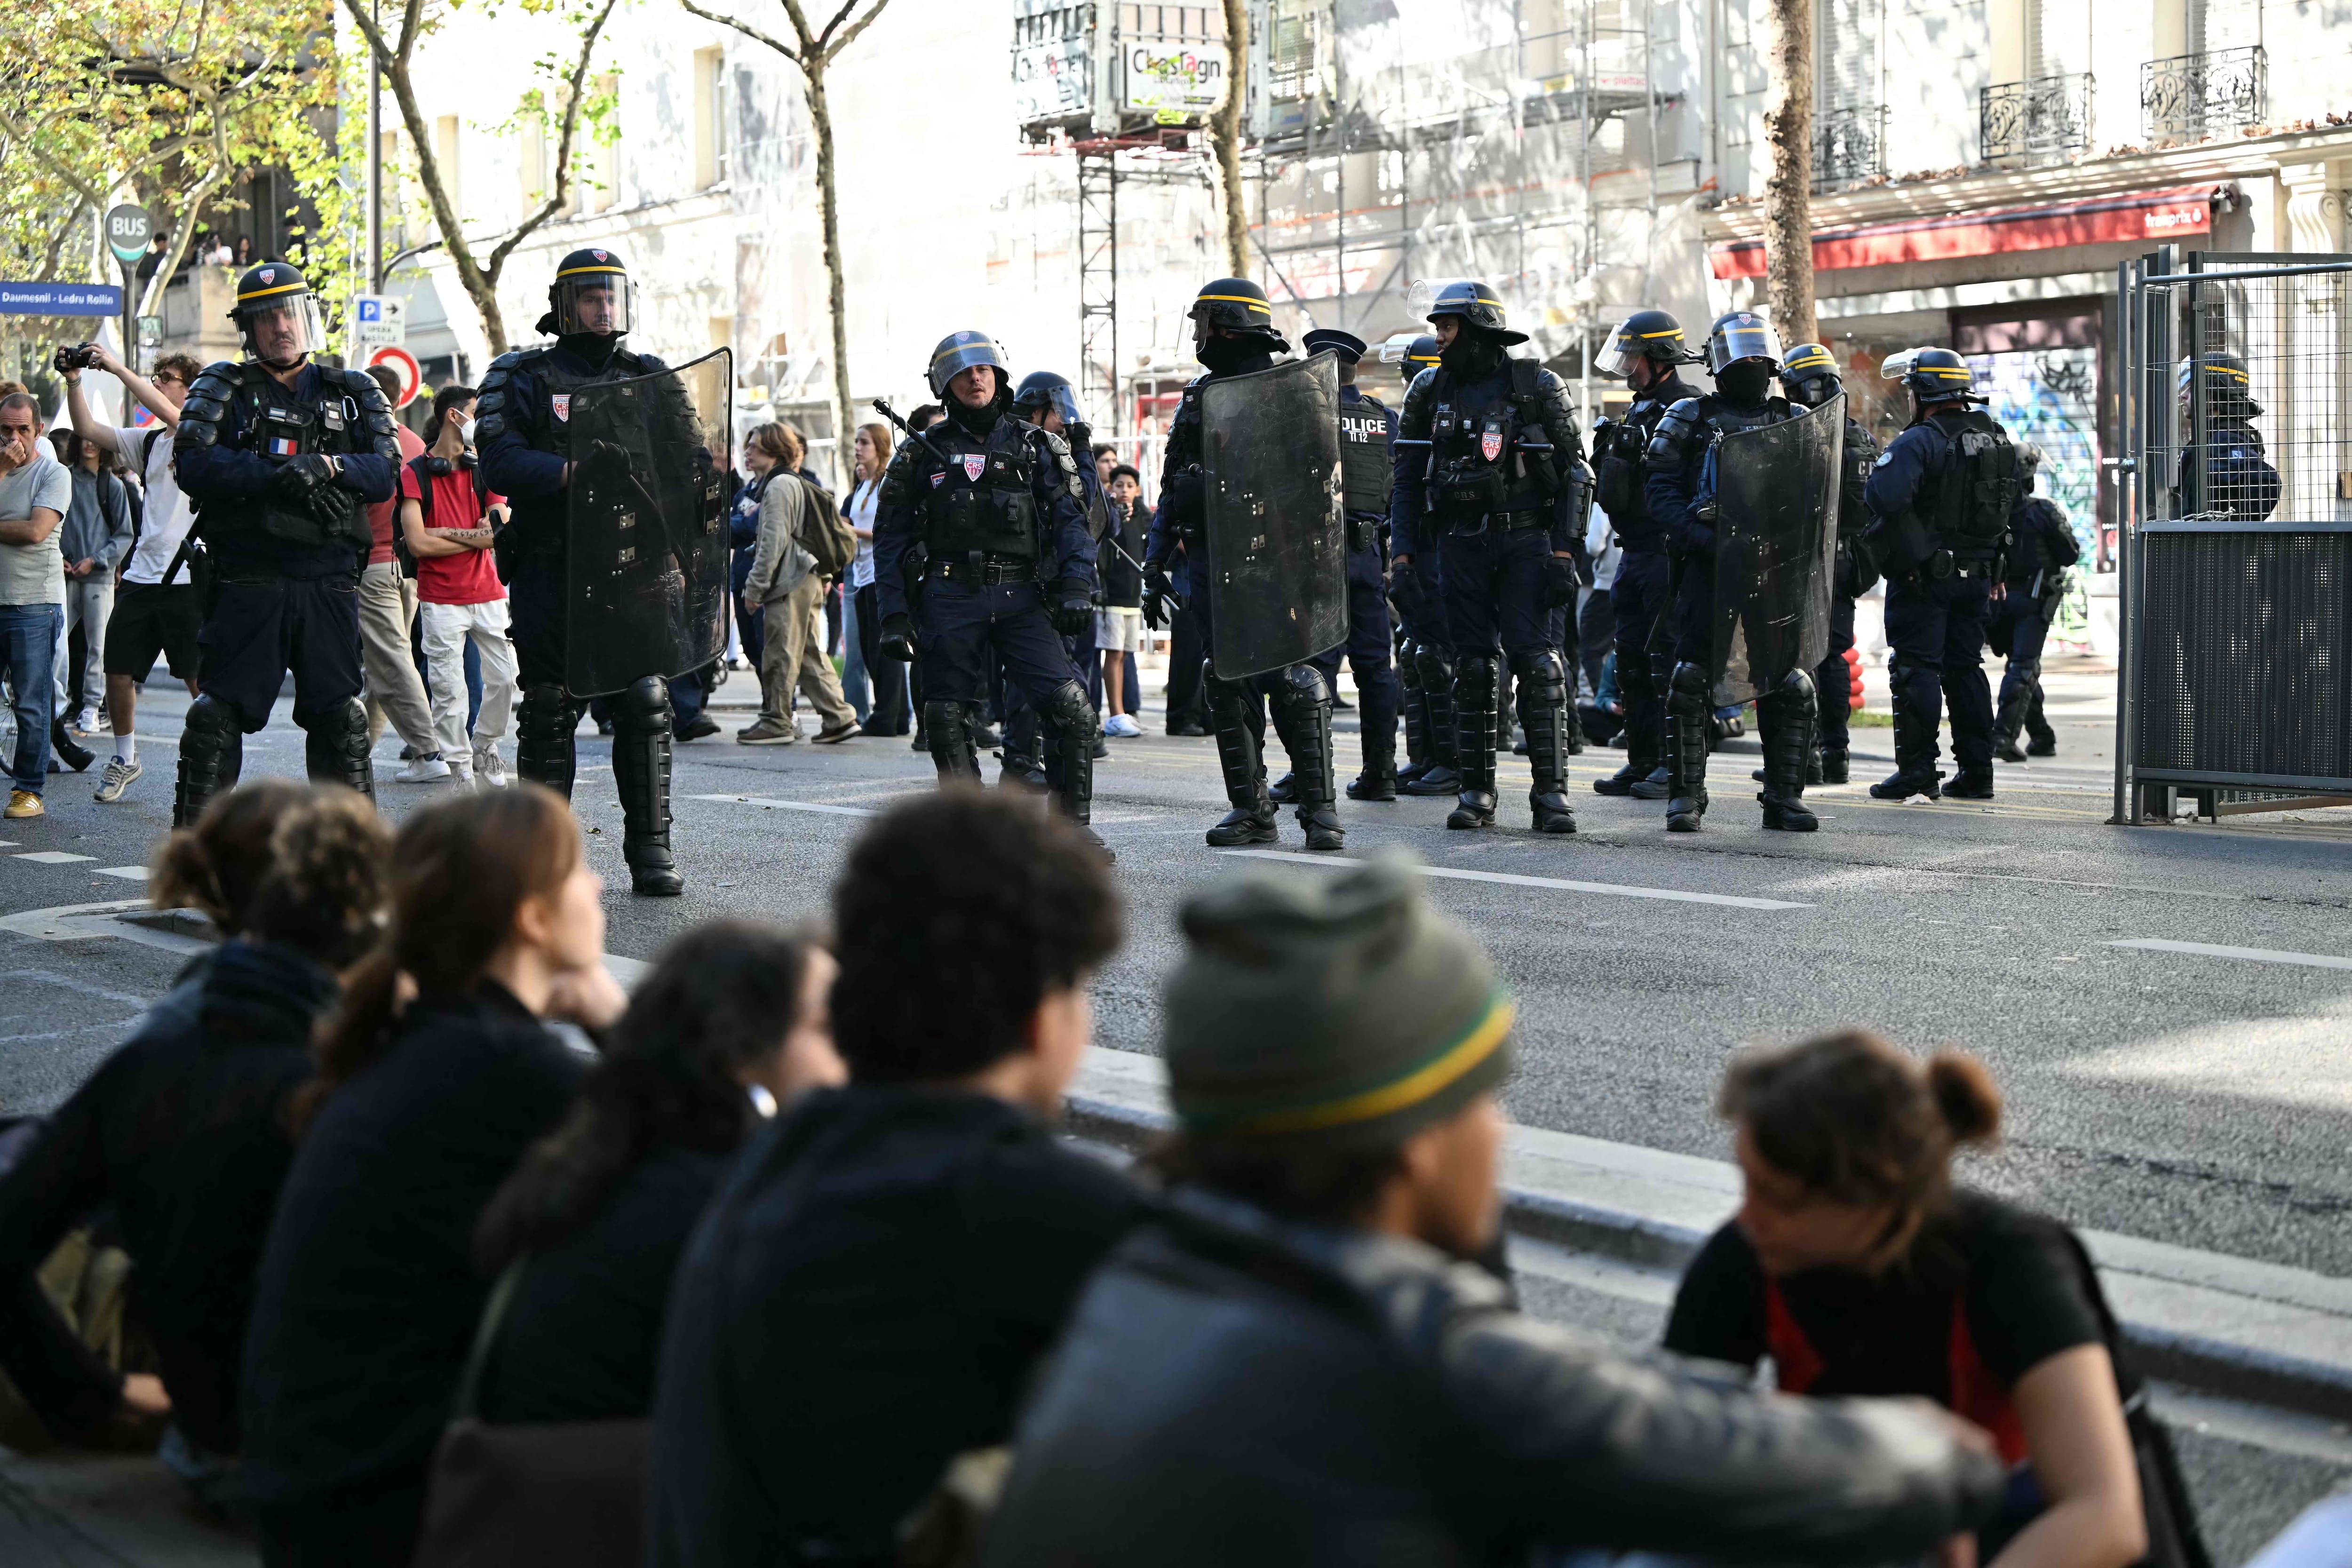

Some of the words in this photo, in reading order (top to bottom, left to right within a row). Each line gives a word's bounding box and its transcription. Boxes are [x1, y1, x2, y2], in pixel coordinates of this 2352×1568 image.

[112, 217, 146, 236] BUS
[2, 292, 51, 303] Daumesnil
[58, 293, 85, 305] Ledru
[87, 294, 113, 305] Rollin
[364, 302, 375, 319] P
[1349, 432, 1357, 442] TI
[1358, 433, 1368, 443] 12
